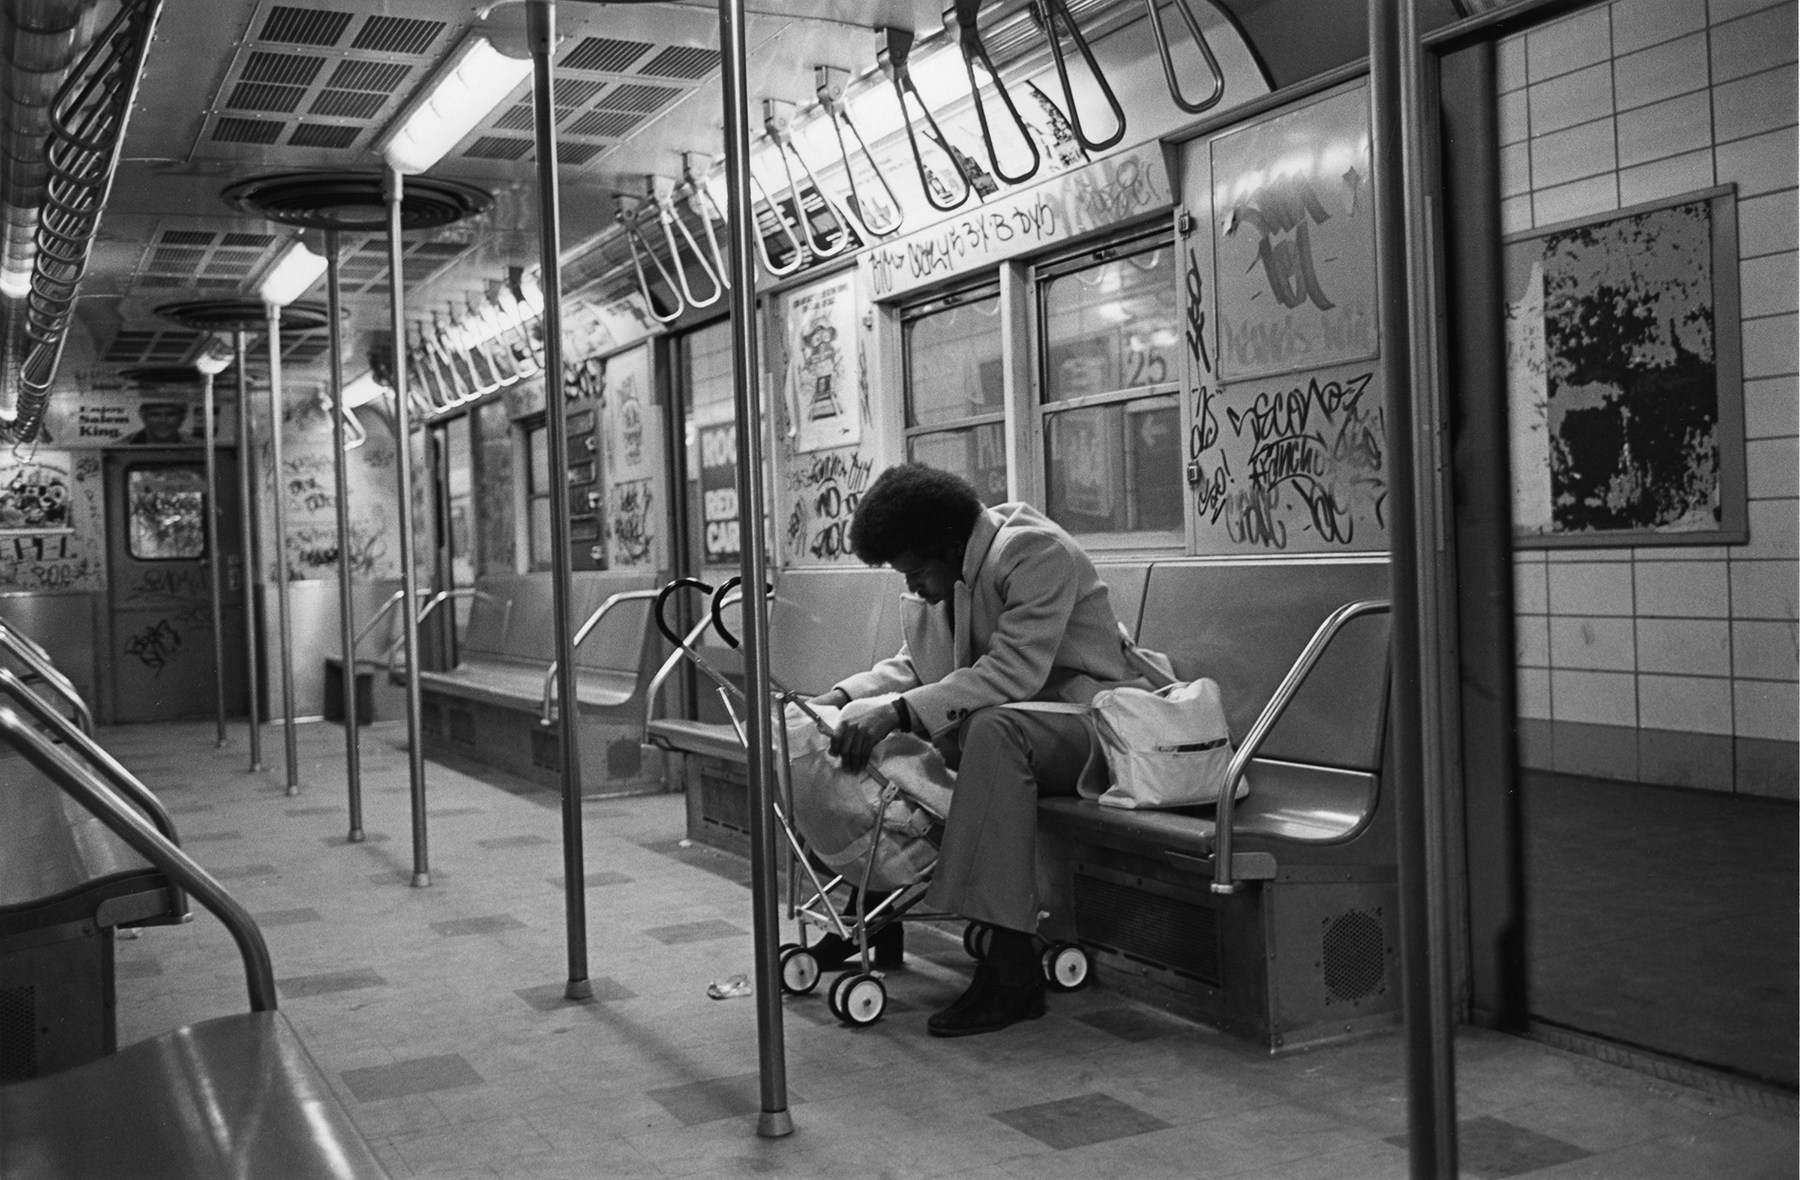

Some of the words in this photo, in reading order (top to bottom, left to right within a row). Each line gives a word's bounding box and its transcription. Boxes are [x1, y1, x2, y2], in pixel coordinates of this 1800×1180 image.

[1127, 348, 1168, 387] 25
[79, 406, 125, 416] Enjoy
[79, 414, 130, 424] Salem
